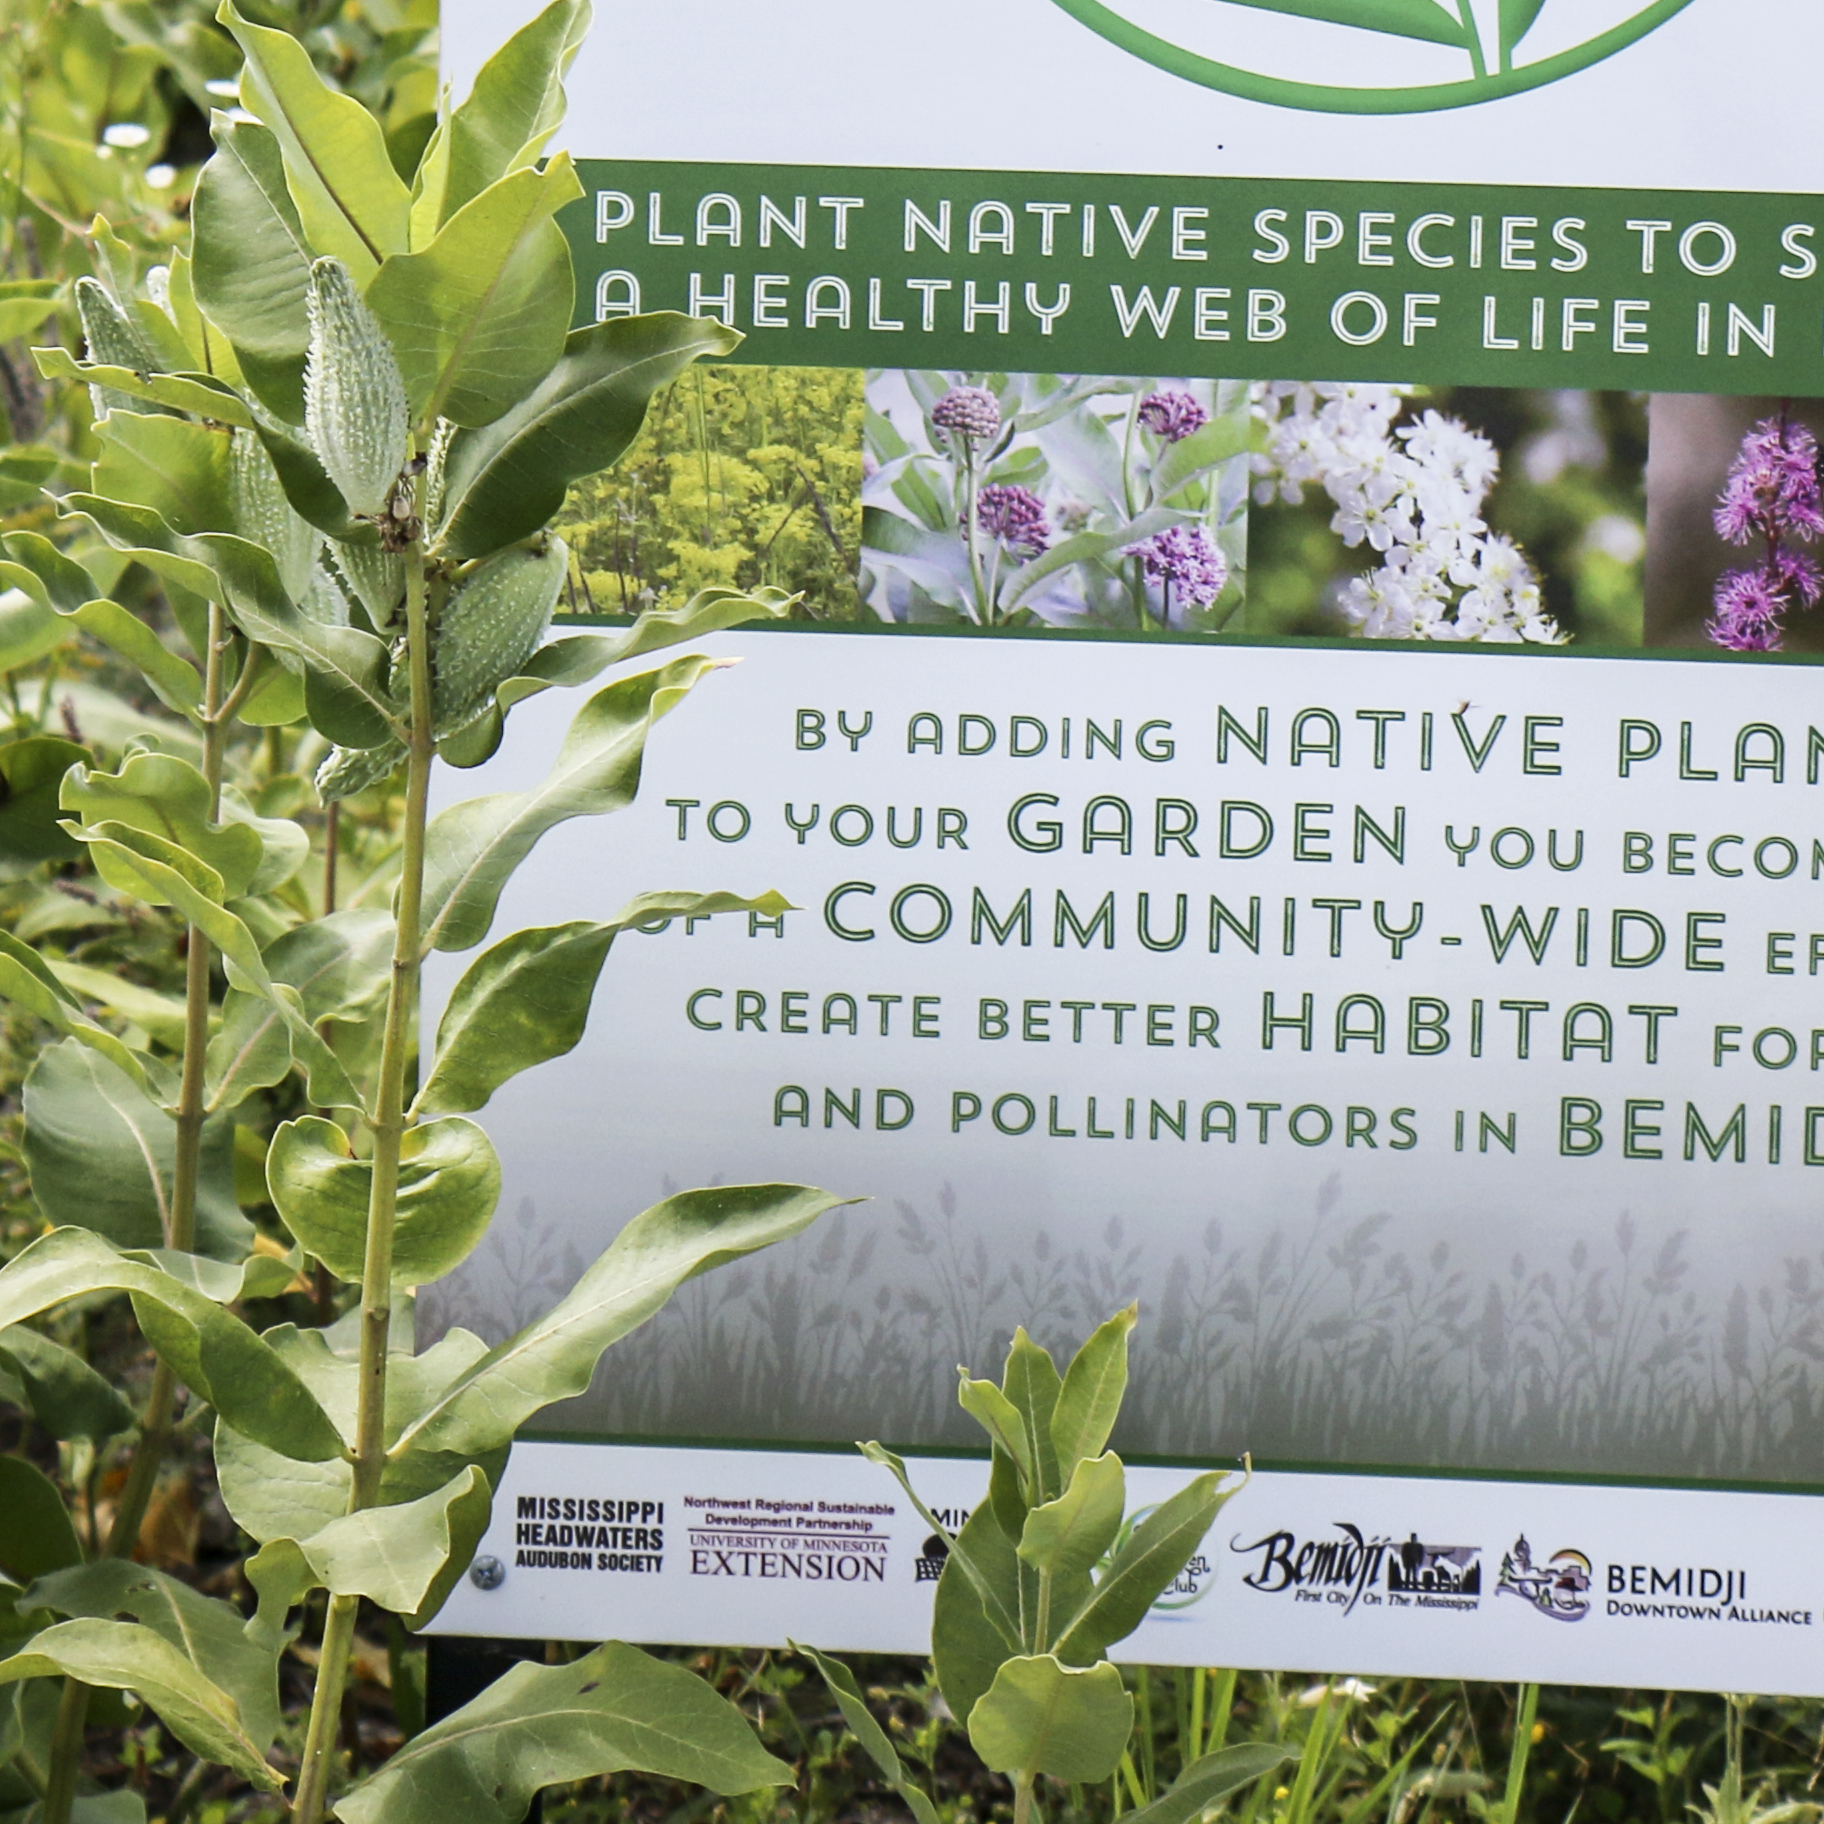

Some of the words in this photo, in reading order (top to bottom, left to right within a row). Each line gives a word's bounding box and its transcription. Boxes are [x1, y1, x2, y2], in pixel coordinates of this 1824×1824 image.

[596, 191, 864, 250] PLANT
[904, 199, 1210, 261] NATIVE
[1252, 208, 1587, 272] SPECIES
[1627, 221, 1737, 276] TO
[596, 270, 641, 322] A
[688, 273, 1071, 335] HEALTHY
[1110, 284, 1288, 343] WEB
[1330, 290, 1440, 347] OF
[1483, 296, 1650, 354] LIFE
[1697, 302, 1776, 359] IN
[795, 709, 873, 752] BY
[906, 712, 1175, 762] ADDING
[1216, 705, 1564, 776] NATIVE
[666, 799, 751, 843] TO
[785, 802, 969, 851] YOUR
[1007, 792, 1405, 865] GARDEN
[1444, 825, 1584, 873] YOU
[823, 881, 1726, 971] COMMUNITY-WIDE
[686, 988, 942, 1039] CREATE
[978, 997, 1221, 1049] BETTER
[1261, 991, 1677, 1064] HABITAT
[774, 1085, 915, 1132] AND
[950, 1091, 1418, 1151] POLLINATORS
[1454, 1109, 1517, 1155] IN
[516, 1496, 664, 1524] MISSISSIPPI
[683, 1496, 751, 1510] Northwest
[755, 1499, 814, 1514] Regional
[817, 1501, 895, 1516] Sustainable
[705, 1514, 793, 1529] Development
[796, 1516, 873, 1532] Partnership
[516, 1524, 663, 1551] HEADWATERS
[690, 1534, 777, 1550] UNIVERSITY
[780, 1537, 798, 1551] OF
[803, 1538, 888, 1554] MINNESOTA
[515, 1550, 592, 1570] AUDUBON
[597, 1552, 664, 1573] SOCIETY
[690, 1550, 886, 1582] EXTENSION
[1230, 1523, 1390, 1617] Bemidji
[1295, 1589, 1322, 1603] First
[1327, 1591, 1350, 1606] City
[1363, 1592, 1382, 1605] On
[1388, 1594, 1411, 1606] The
[1415, 1595, 1479, 1610] Mississippi
[1607, 1564, 1746, 1606] BEMIDJI
